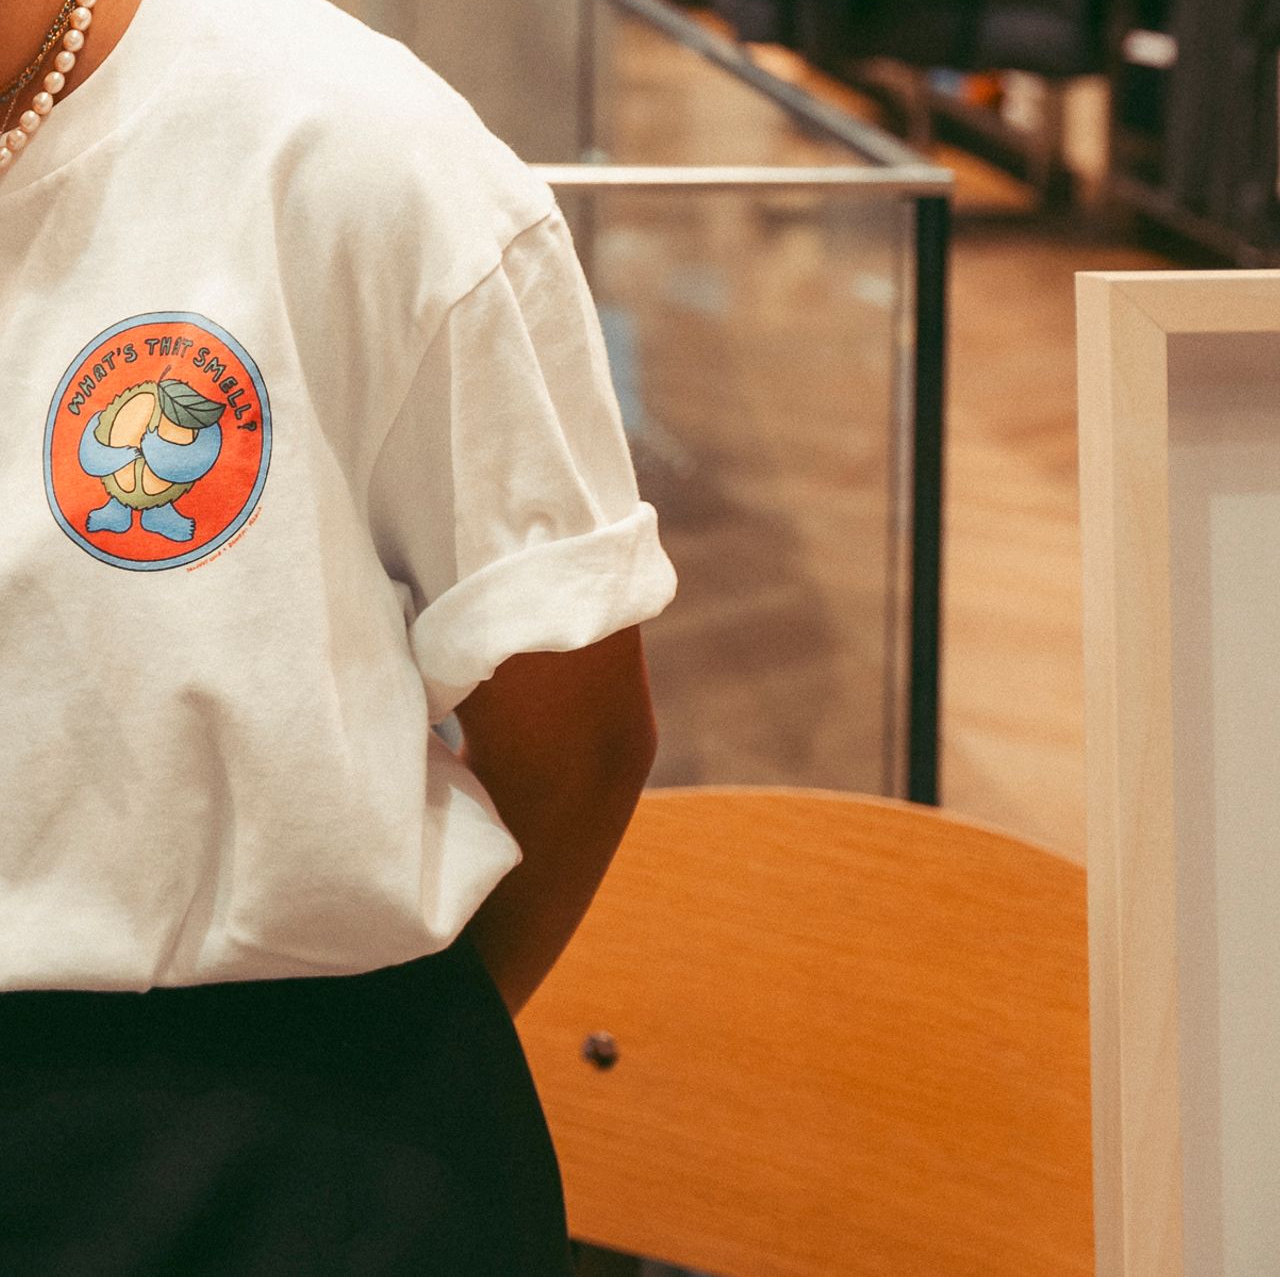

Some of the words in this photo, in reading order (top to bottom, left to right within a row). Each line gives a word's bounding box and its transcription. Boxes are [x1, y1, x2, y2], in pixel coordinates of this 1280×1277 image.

[68, 343, 139, 415] WHAT'S
[144, 337, 194, 358] THAT
[193, 347, 258, 432] SMELL?
